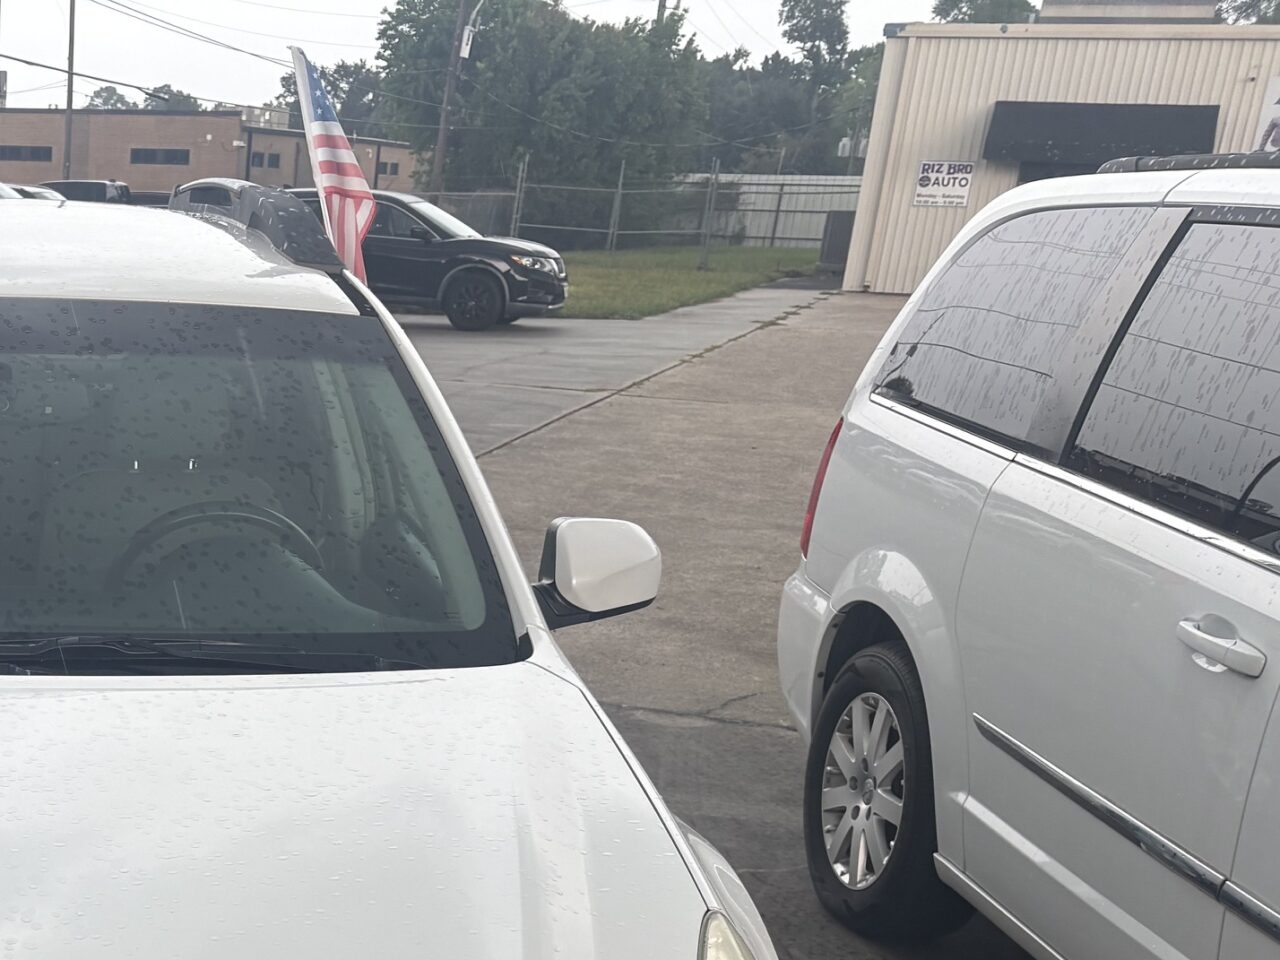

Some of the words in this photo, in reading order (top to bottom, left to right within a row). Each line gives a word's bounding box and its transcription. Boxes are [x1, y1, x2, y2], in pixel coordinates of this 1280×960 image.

[921, 163, 944, 174] RIZ
[946, 163, 973, 175] BRO
[931, 177, 969, 187] AUTO
